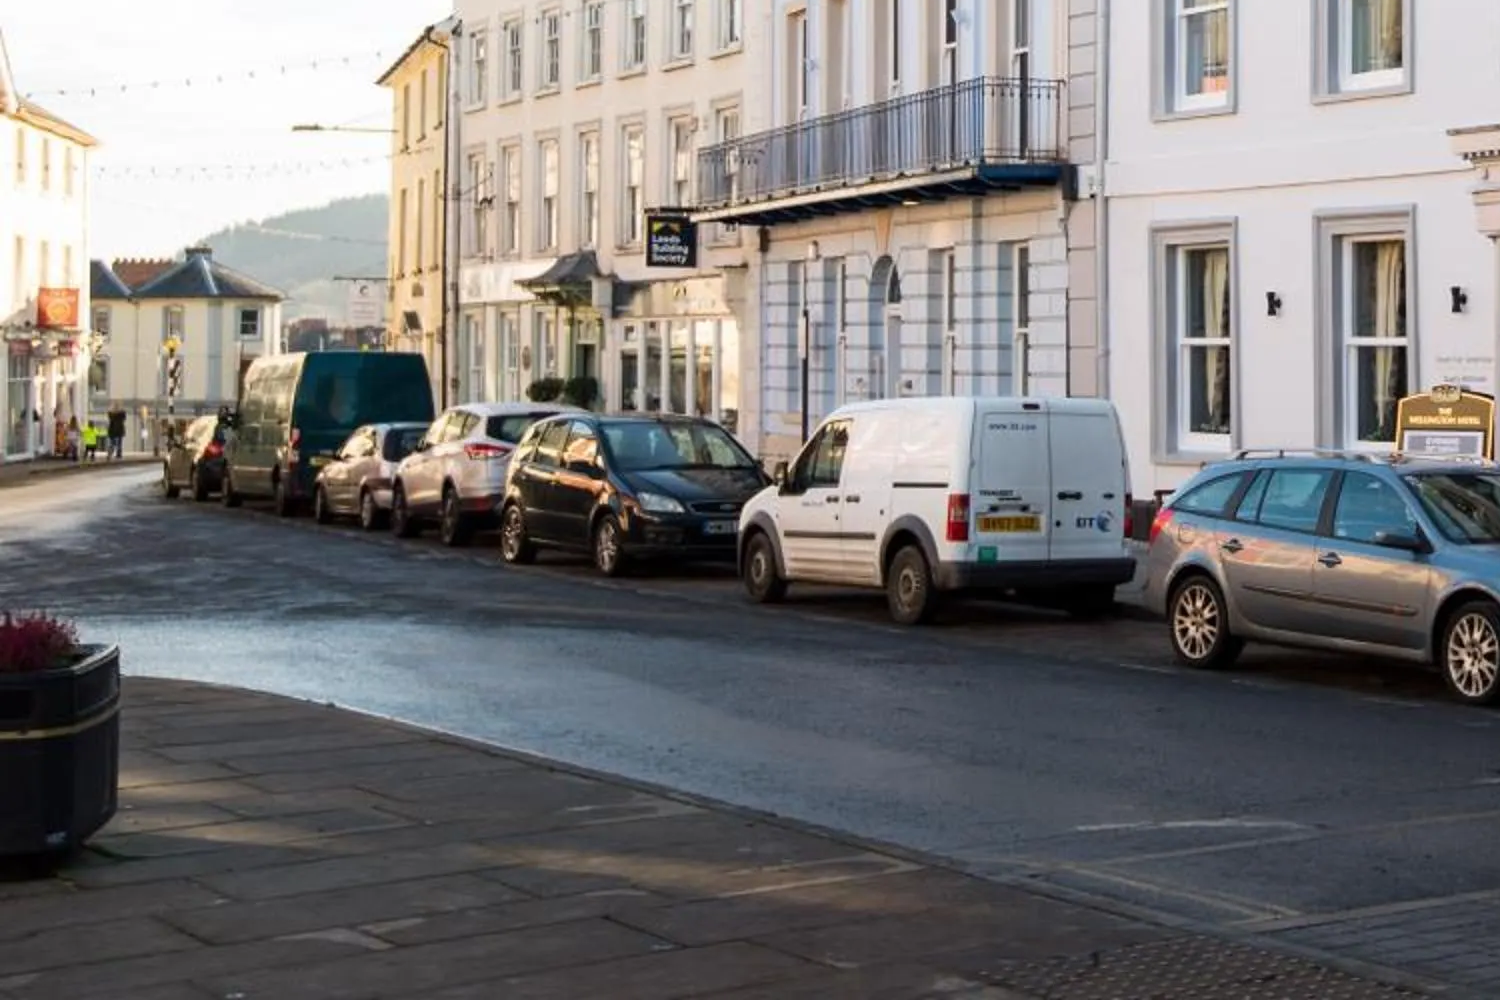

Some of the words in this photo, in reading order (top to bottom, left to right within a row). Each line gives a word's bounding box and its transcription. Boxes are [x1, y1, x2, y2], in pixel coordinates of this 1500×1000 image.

[652, 235, 681, 243] Leeds
[652, 244, 689, 255] Building
[652, 254, 688, 265] Society
